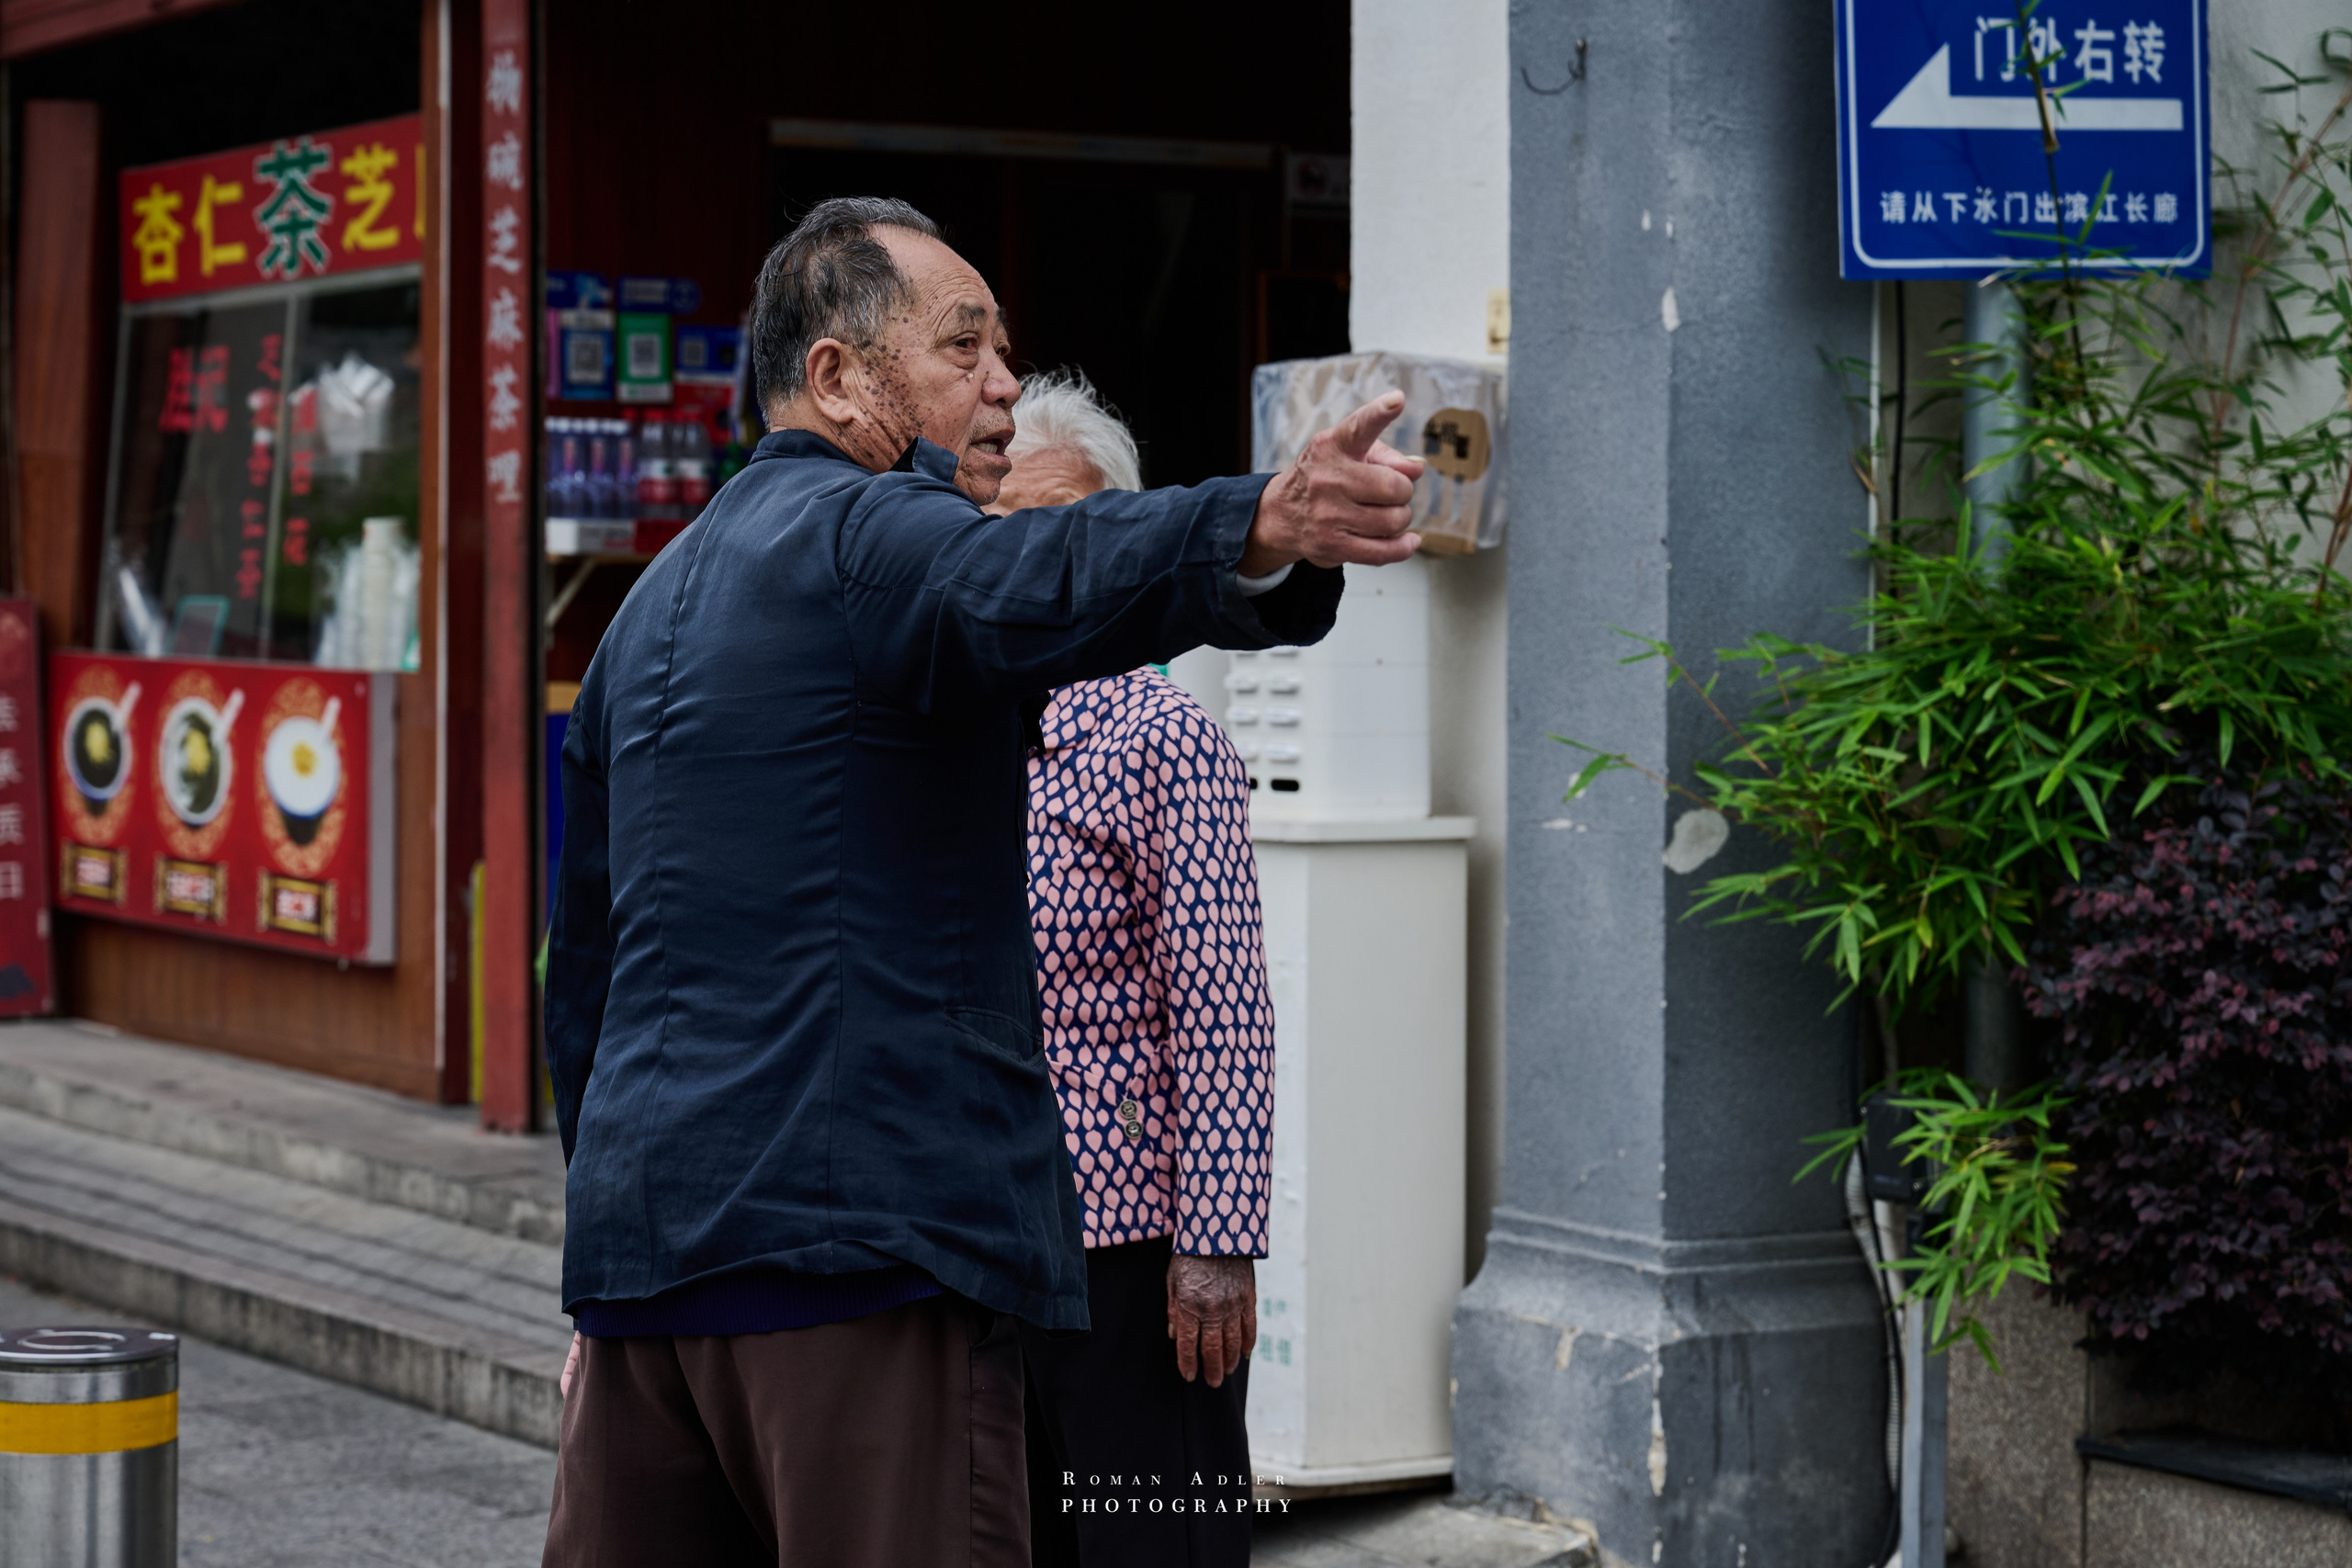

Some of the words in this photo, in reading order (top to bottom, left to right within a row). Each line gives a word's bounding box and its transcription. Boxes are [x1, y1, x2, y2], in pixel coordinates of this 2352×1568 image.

[1974, 17, 2165, 84] 门外右转
[132, 137, 425, 285] 杏仁茶芝
